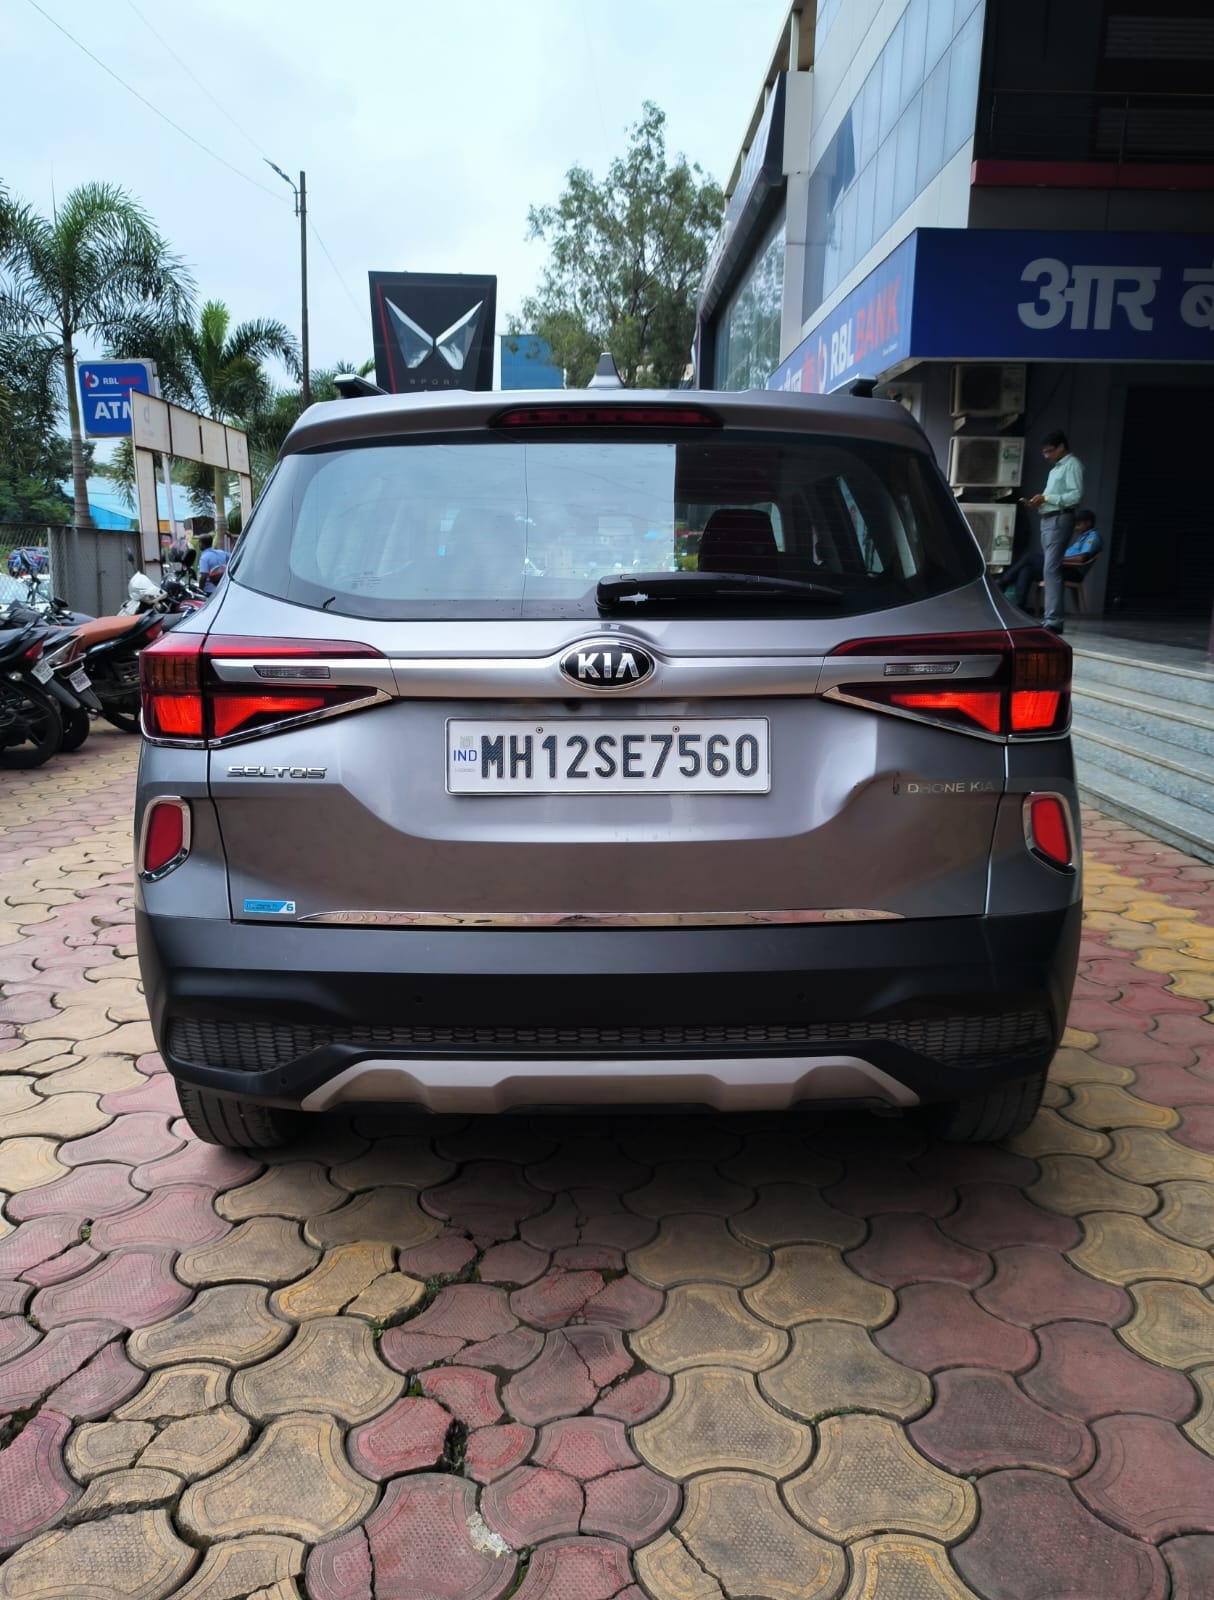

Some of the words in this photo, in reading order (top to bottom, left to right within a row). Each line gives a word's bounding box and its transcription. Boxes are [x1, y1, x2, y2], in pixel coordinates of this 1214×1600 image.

[1017, 257, 1162, 331] आर
[576, 652, 640, 678] KIA
[453, 749, 477, 762] IND
[227, 765, 327, 779] SELTOS
